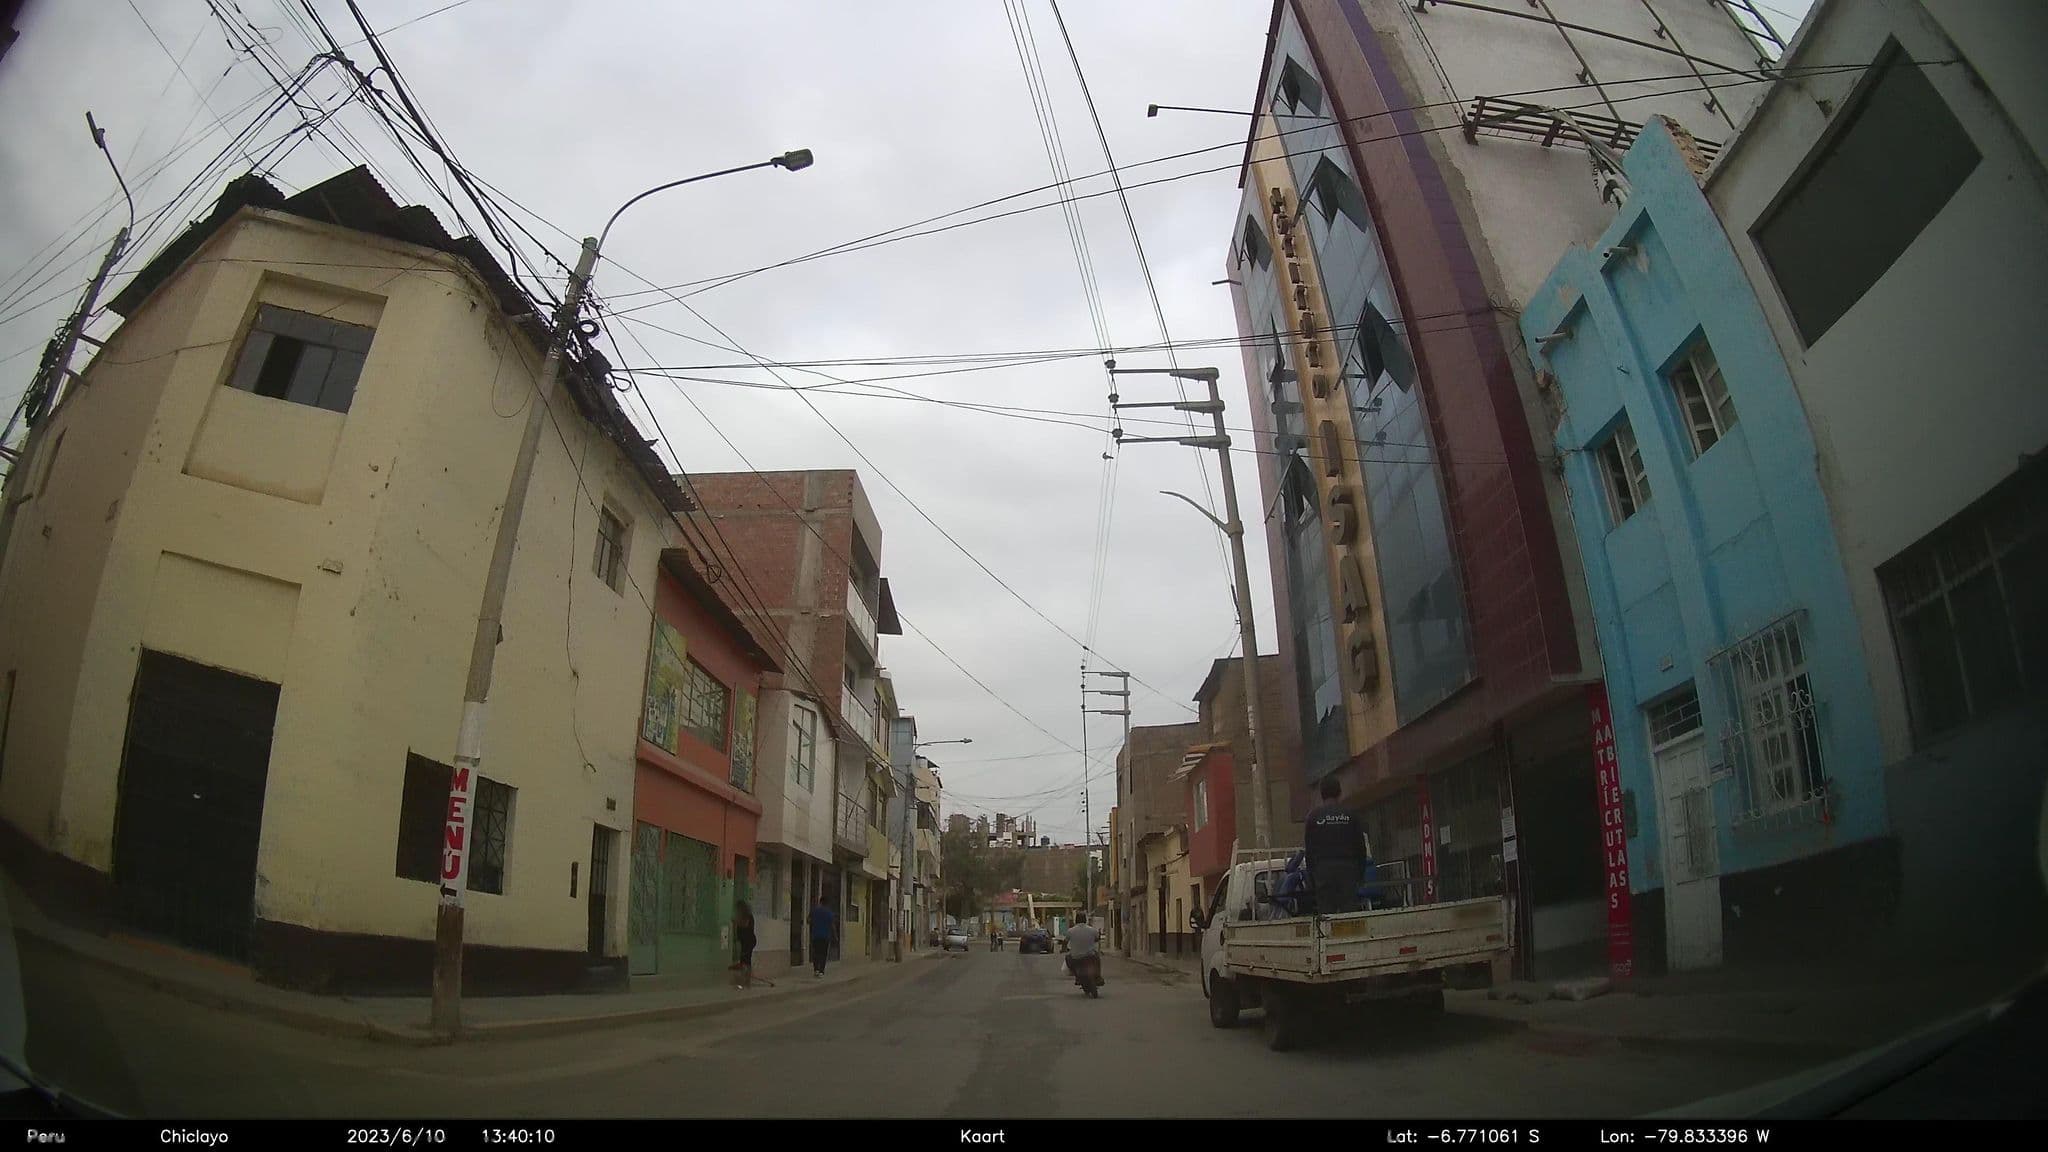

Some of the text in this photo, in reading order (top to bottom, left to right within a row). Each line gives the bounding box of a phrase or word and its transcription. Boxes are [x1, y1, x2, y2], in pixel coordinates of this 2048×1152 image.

[441, 767, 470, 880] MENÚ
[1591, 708, 1618, 909] MATRÍCULAS
[1605, 724, 1627, 887] ABIERTAS
